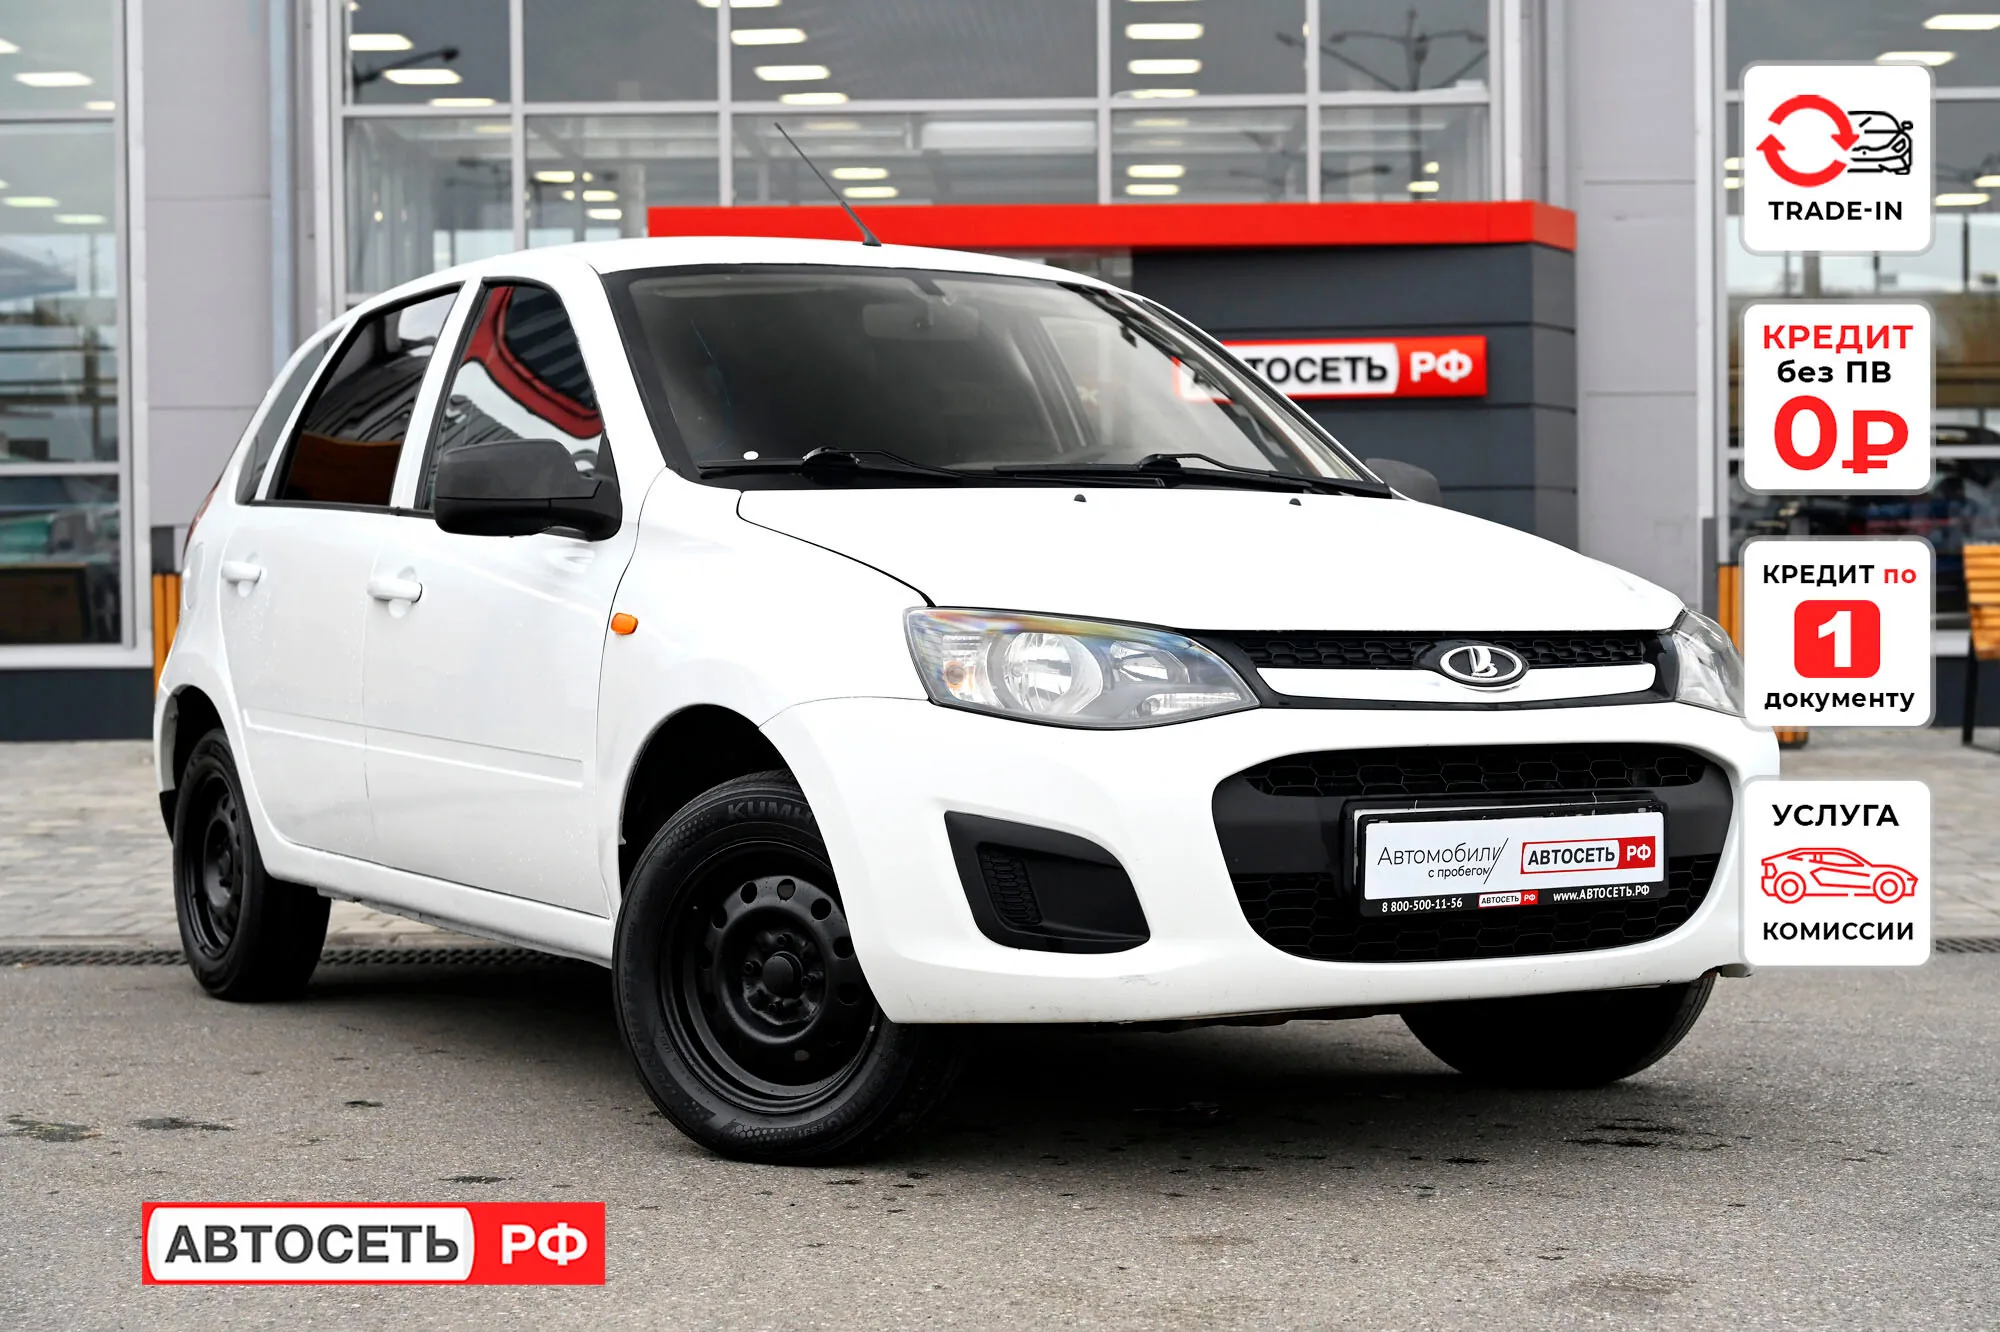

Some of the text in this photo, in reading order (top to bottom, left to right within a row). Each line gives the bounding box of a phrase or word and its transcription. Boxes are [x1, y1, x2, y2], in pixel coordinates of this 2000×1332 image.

[1410, 348, 1473, 382] РФ
[1377, 842, 1503, 866] Автомобили
[1528, 844, 1651, 866] АВТОСЕТЬ РФ
[1428, 870, 1435, 878] с
[1481, 893, 1536, 905] АВТОСЕТЬ РФ
[1553, 884, 1650, 902] www.АВТОСЕТЬ.РФ
[1381, 897, 1463, 913] 8 800-500-11-56
